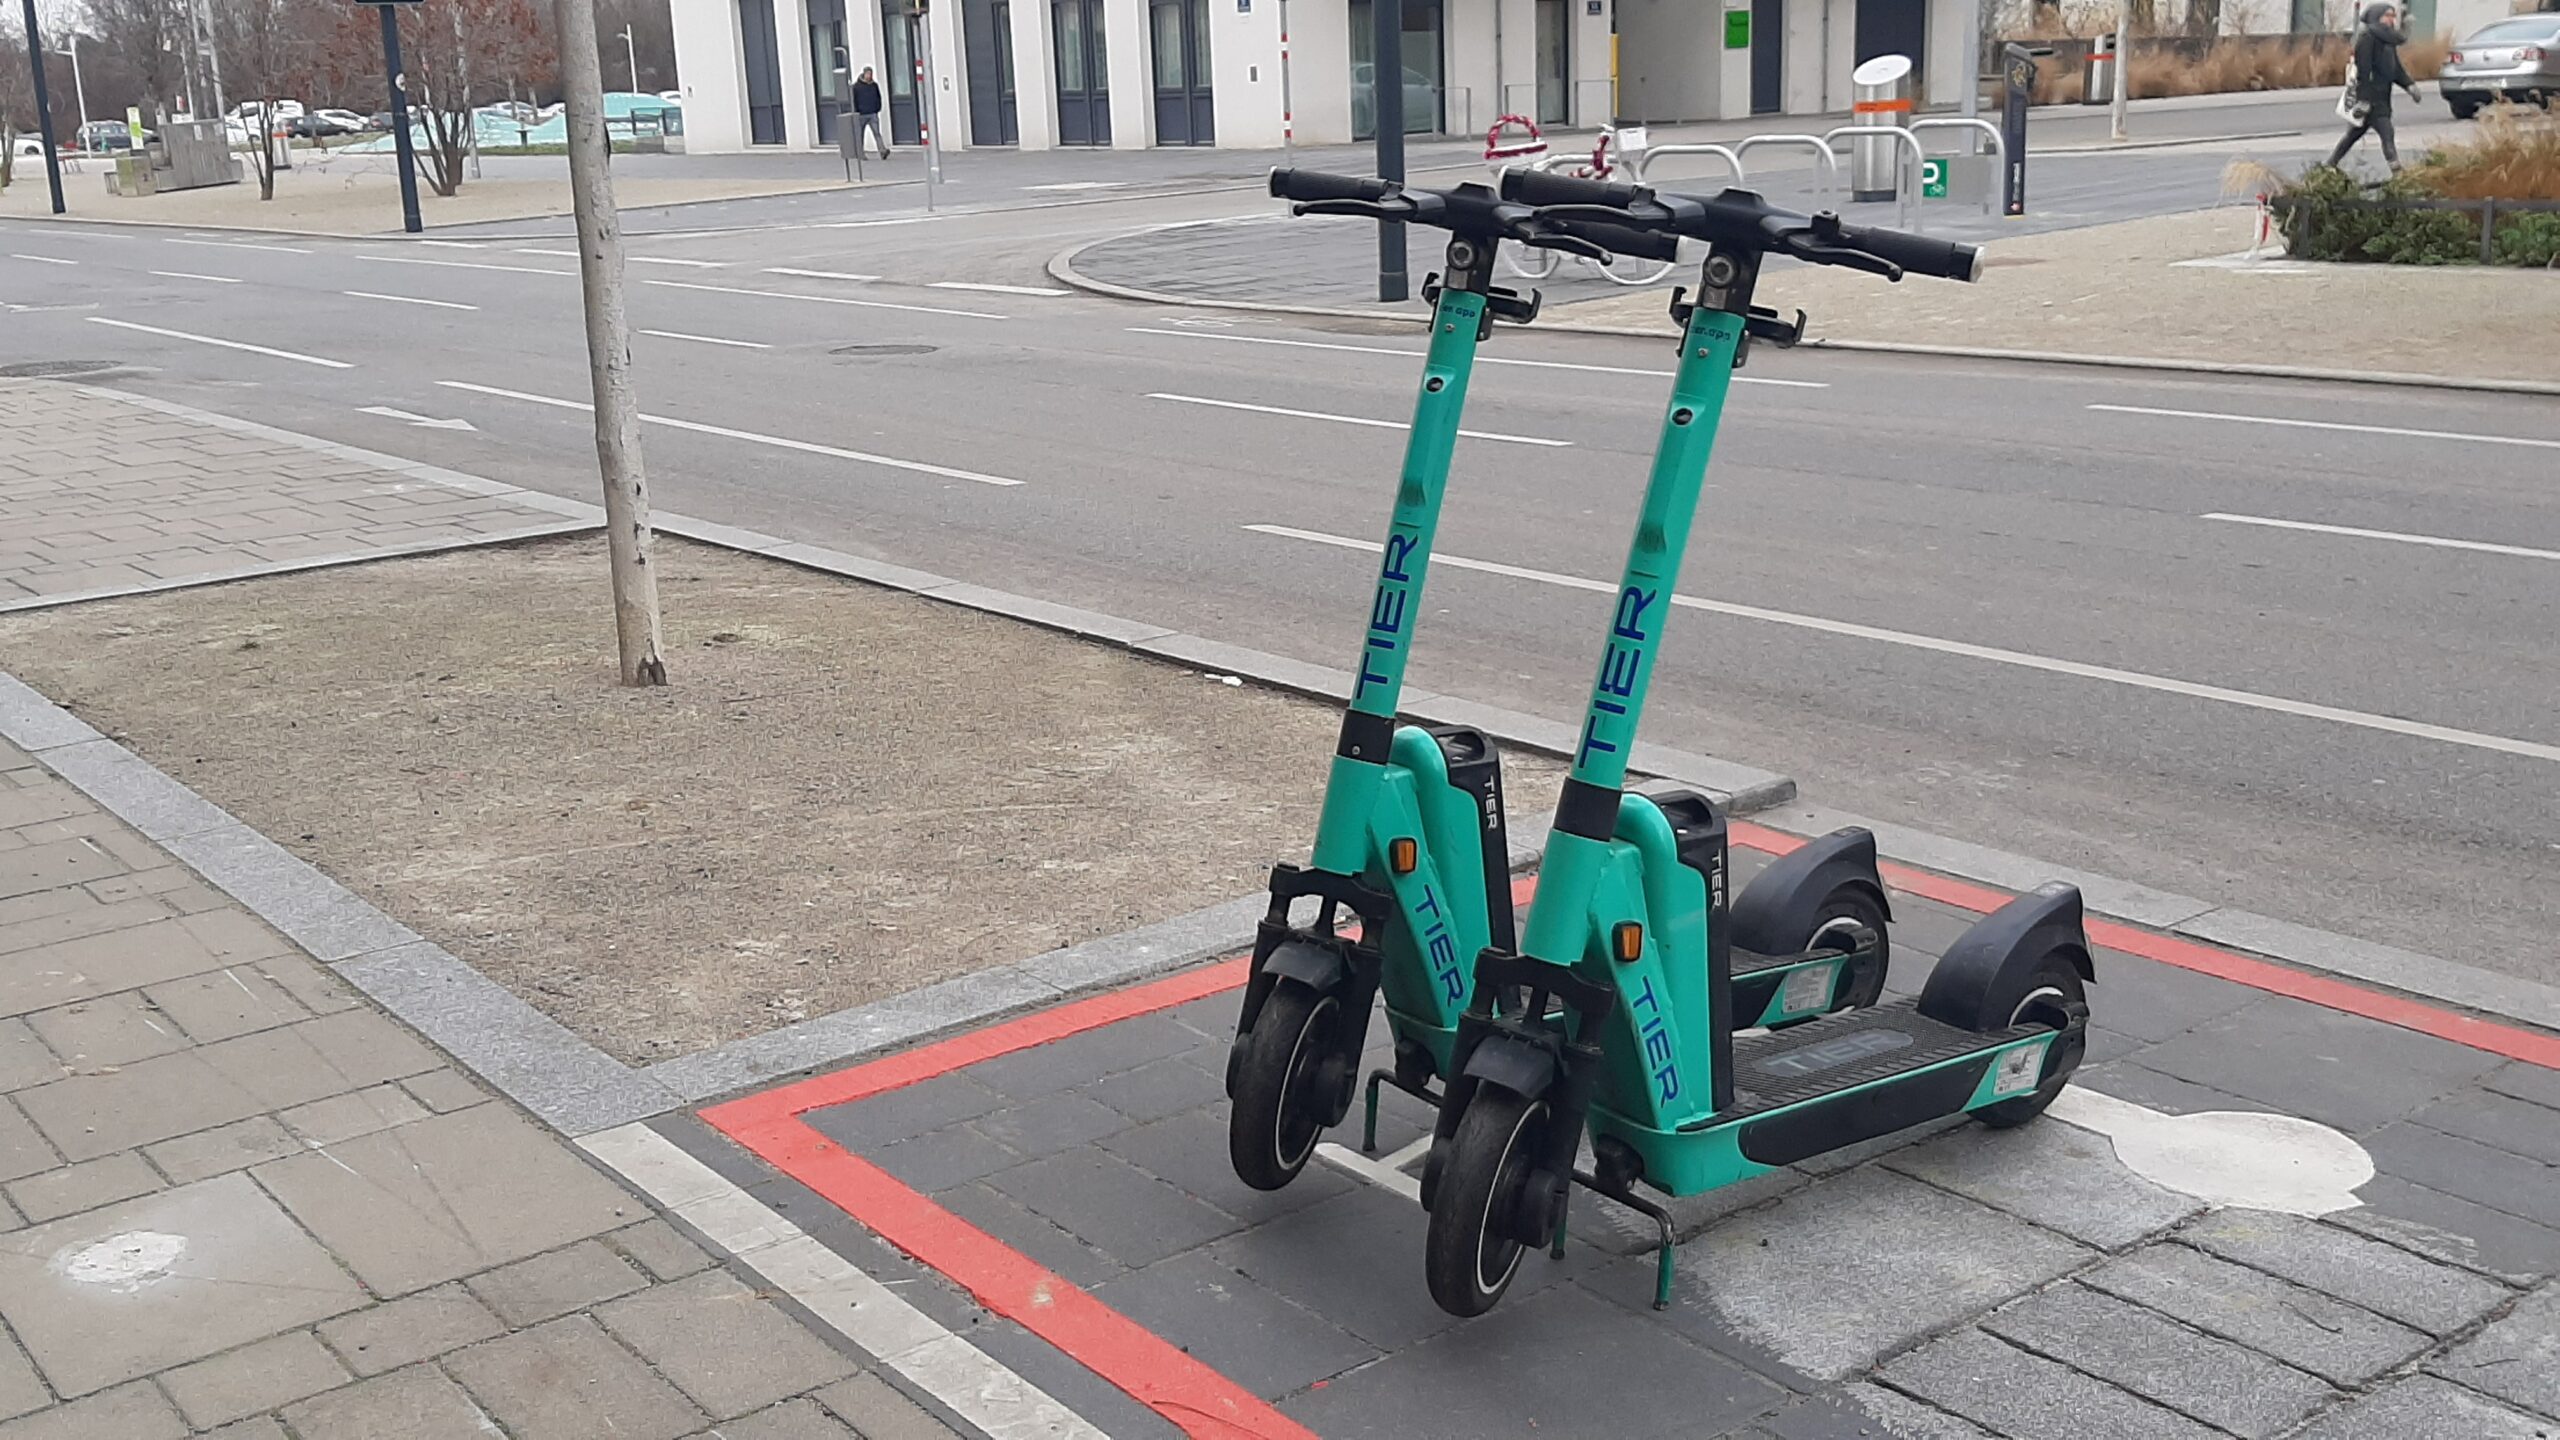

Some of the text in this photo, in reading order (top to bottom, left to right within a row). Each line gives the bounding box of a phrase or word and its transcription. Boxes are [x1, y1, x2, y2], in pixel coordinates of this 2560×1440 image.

[1356, 533, 1419, 700] TIER
[1578, 586, 1657, 769] TIER
[1484, 775, 1498, 831] TIER
[1711, 848, 1722, 911] TIER
[1415, 884, 1464, 1008] TIER
[1633, 975, 1679, 1109] TIER
[1766, 1032, 1901, 1070] TIER
